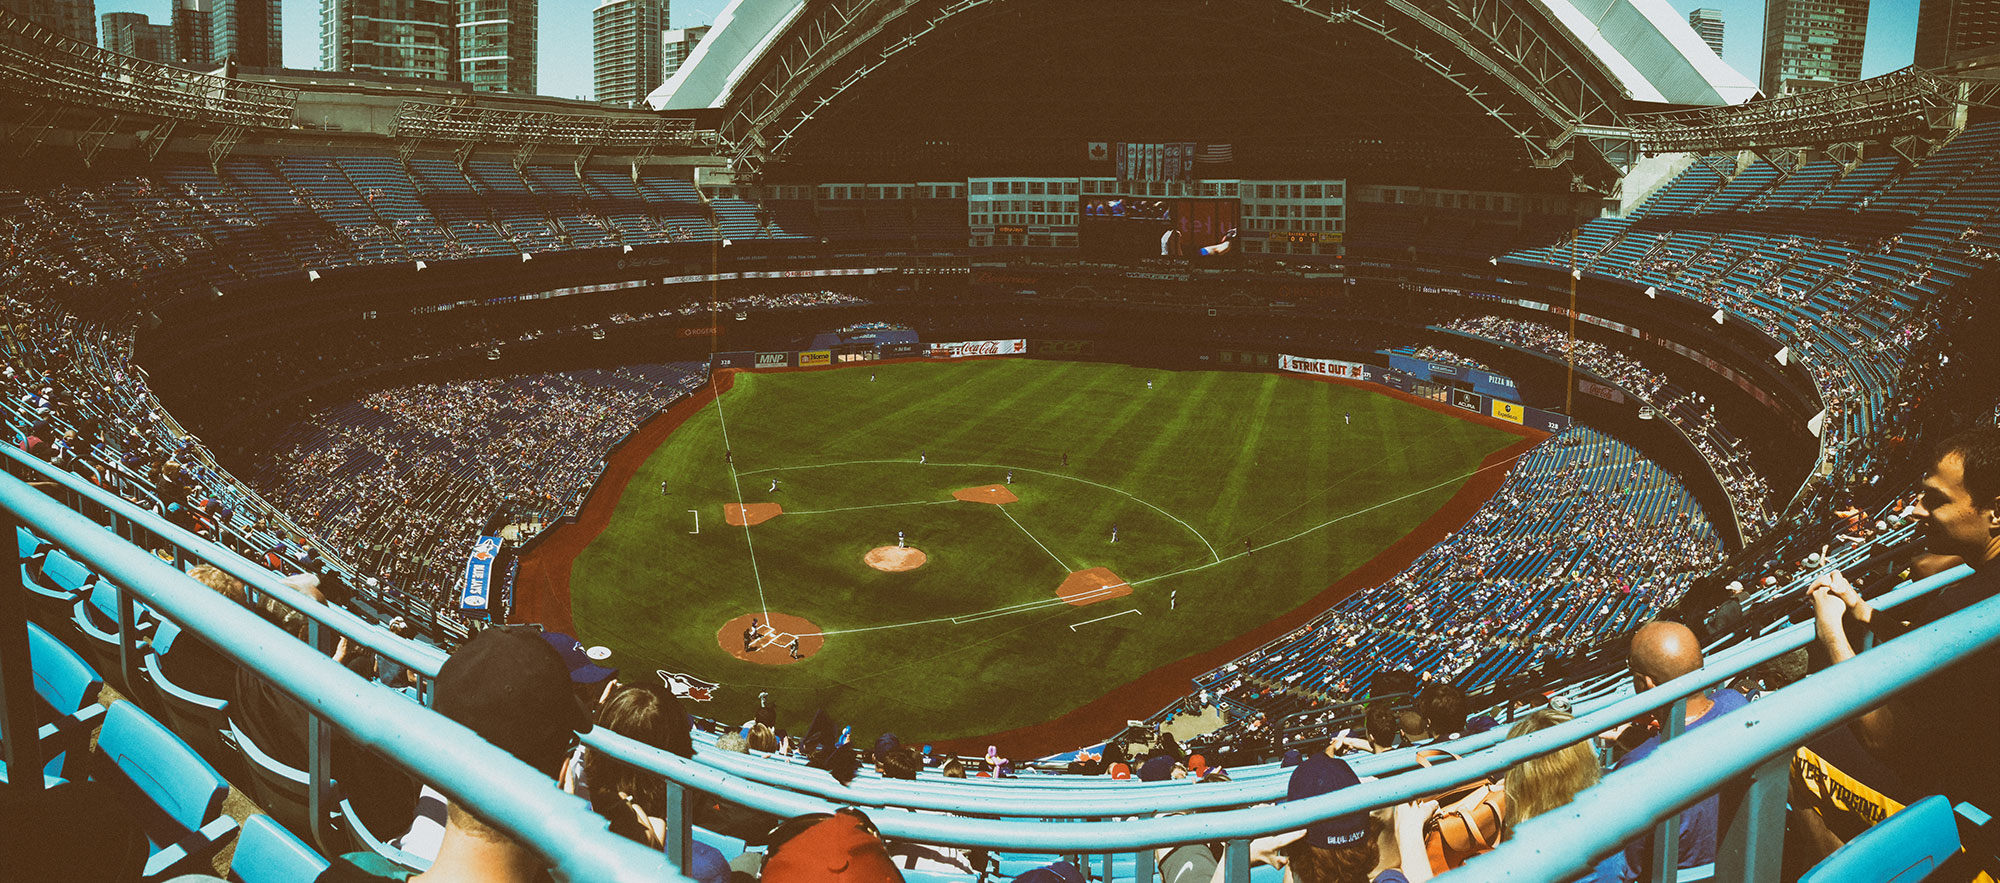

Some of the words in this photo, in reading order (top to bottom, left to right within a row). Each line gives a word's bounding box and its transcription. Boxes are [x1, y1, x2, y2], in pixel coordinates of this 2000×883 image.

[692, 328, 717, 336] ROGERS
[1039, 341, 1090, 353] acer
[759, 354, 784, 364] MNP
[810, 353, 829, 361] Home
[1292, 359, 1326, 374] STRIKE
[1328, 364, 1348, 376] OUT
[1488, 375, 1505, 386] PIZZA
[1458, 401, 1476, 410] ACURA
[1547, 421, 1559, 430] 328
[472, 564, 486, 579] BLUE
[470, 579, 483, 595] JAYS
[1795, 755, 1828, 783] WEST
[1829, 777, 1888, 823] VIRGINIA
[1327, 835, 1348, 845] BLUE
[1348, 830, 1365, 843] JAYS
